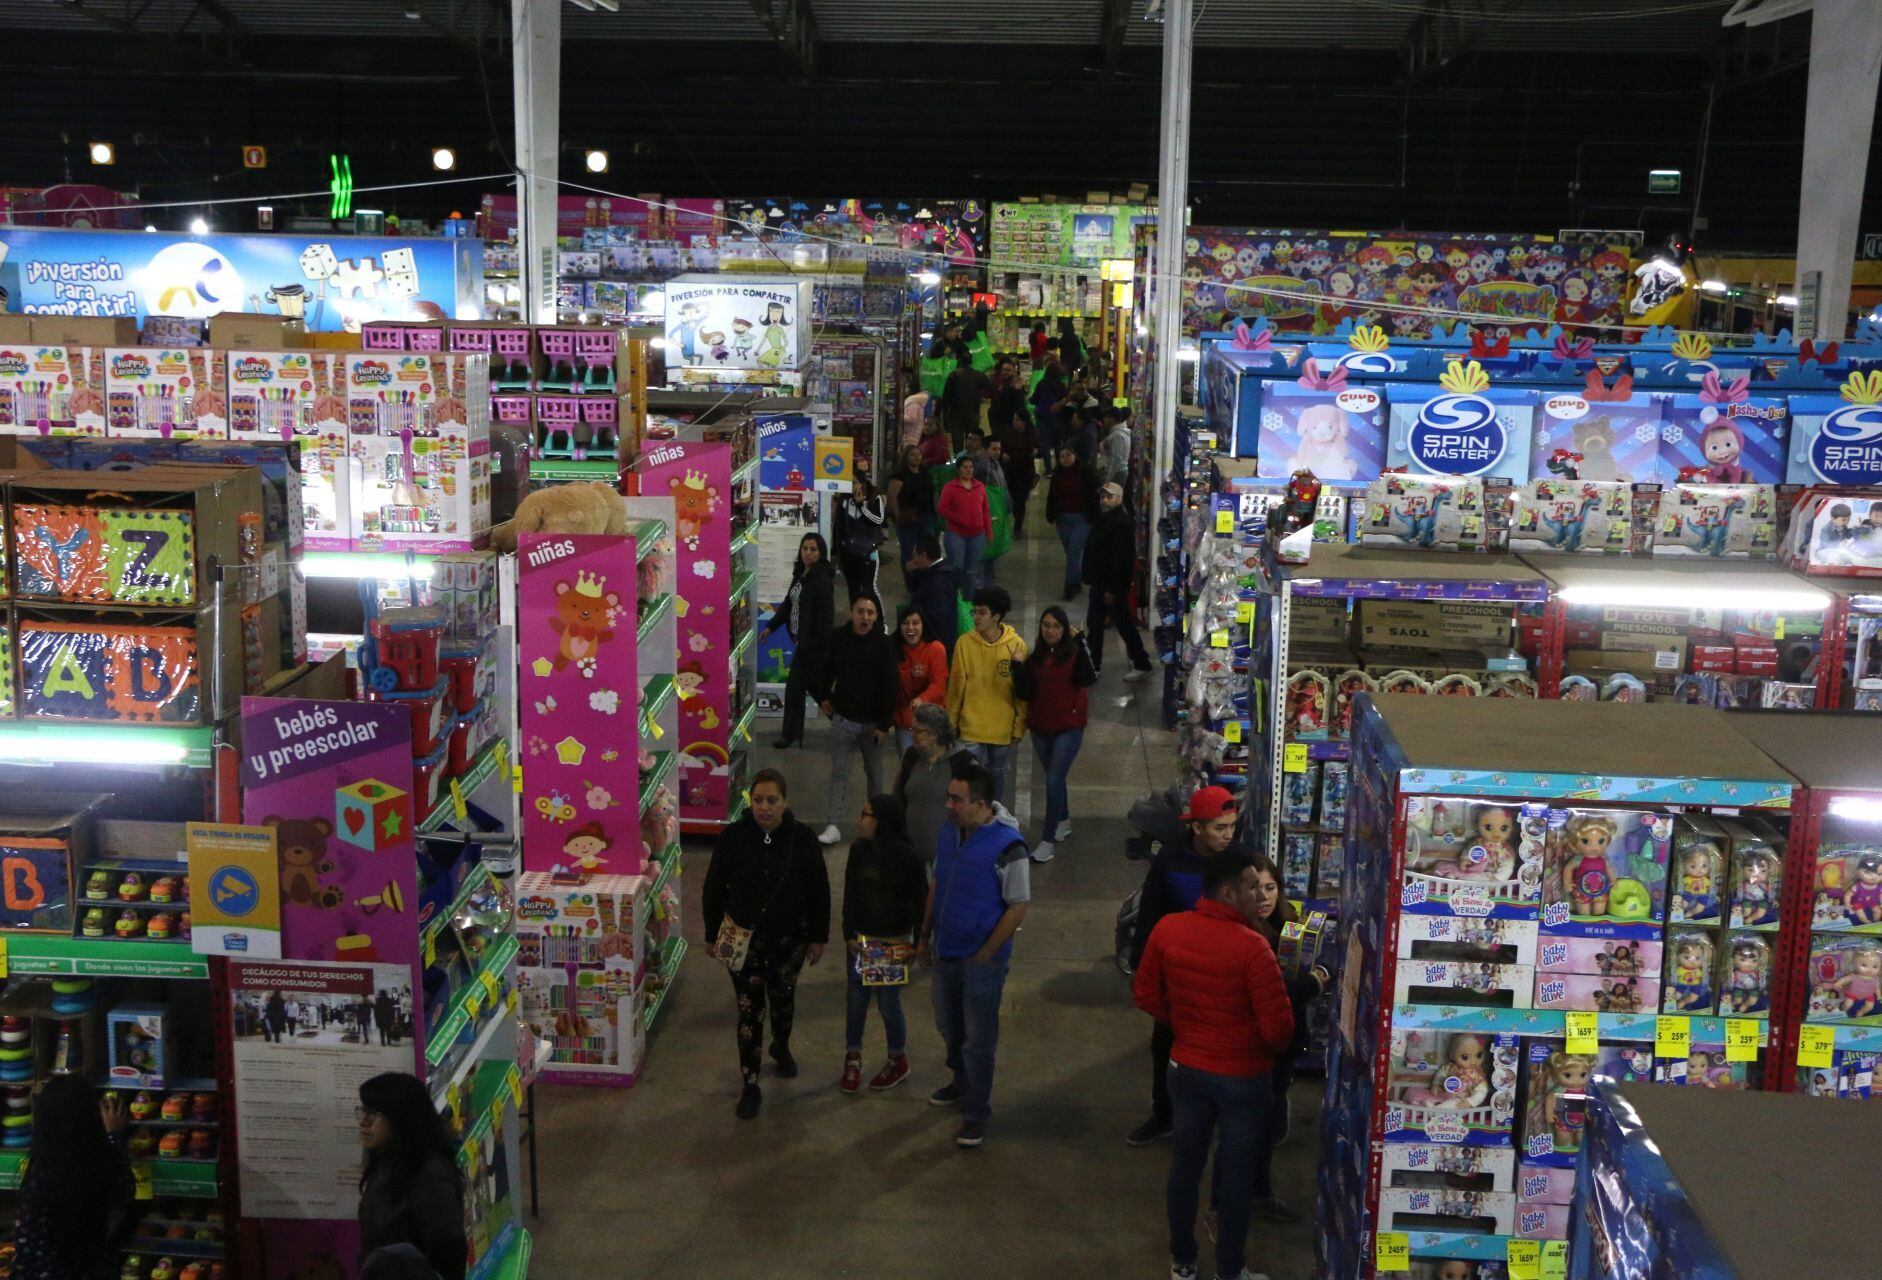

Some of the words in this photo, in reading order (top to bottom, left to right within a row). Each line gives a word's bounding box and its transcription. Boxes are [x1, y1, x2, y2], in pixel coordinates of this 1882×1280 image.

[717, 289, 739, 297] PARA
[742, 288, 792, 305] COMPARTIR
[1728, 404, 1758, 418] Masha
[760, 420, 787, 438] niños
[1424, 435, 1490, 449] SPIN
[649, 445, 685, 466] niñas
[1824, 460, 1882, 471] MASTE
[121, 529, 172, 588] Z
[527, 538, 576, 567] niñas
[1442, 605, 1503, 617] PRESCHOOL
[1634, 611, 1675, 623] TOYS
[1388, 627, 1430, 638] TOYS
[1613, 622, 1678, 634] PRESCHOOL
[43, 645, 95, 700] A
[274, 704, 338, 740] bebés
[251, 755, 267, 779] y
[269, 719, 380, 774] preescolar
[2, 857, 45, 911] B
[1402, 882, 1425, 896] baby
[1402, 892, 1426, 905] alive
[1455, 906, 1488, 915] VERDAD
[1545, 902, 1568, 915] baby
[1429, 918, 1450, 931] baby
[1545, 913, 1569, 925] alive
[1429, 927, 1450, 938] alive
[1543, 943, 1566, 956] baby
[1543, 954, 1566, 966] alive
[242, 967, 288, 977] DECÁLOGO
[302, 971, 318, 979] TUS
[319, 972, 365, 981] DERECHOS
[1426, 964, 1446, 976] baby
[242, 977, 269, 985] COMO
[270, 979, 327, 989] CONSUMIDOR
[1426, 973, 1447, 984] alive
[1541, 982, 1564, 993] baby
[1541, 991, 1565, 1003] alive
[1577, 1028, 1592, 1036] 1659
[1657, 1032, 1662, 1040] $
[1671, 1032, 1684, 1040] 259
[1727, 1036, 1732, 1044] $
[1740, 1036, 1753, 1044] 259
[1801, 1041, 1805, 1049] $
[1385, 1111, 1402, 1123] aby
[1385, 1119, 1403, 1132] live
[1430, 1132, 1462, 1141] VERDAD
[1529, 1134, 1552, 1147] baby
[1408, 1148, 1428, 1160] baby
[1529, 1144, 1553, 1157] alive
[1408, 1156, 1428, 1168] alive
[1525, 1175, 1547, 1188] baby
[1410, 1191, 1430, 1203] baby
[1525, 1185, 1548, 1198] alive
[1410, 1199, 1430, 1211] alive
[1522, 1211, 1544, 1224] baby
[1522, 1221, 1545, 1233] alive
[1388, 1245, 1404, 1254] 2459
[1519, 1254, 1534, 1262] 1659
